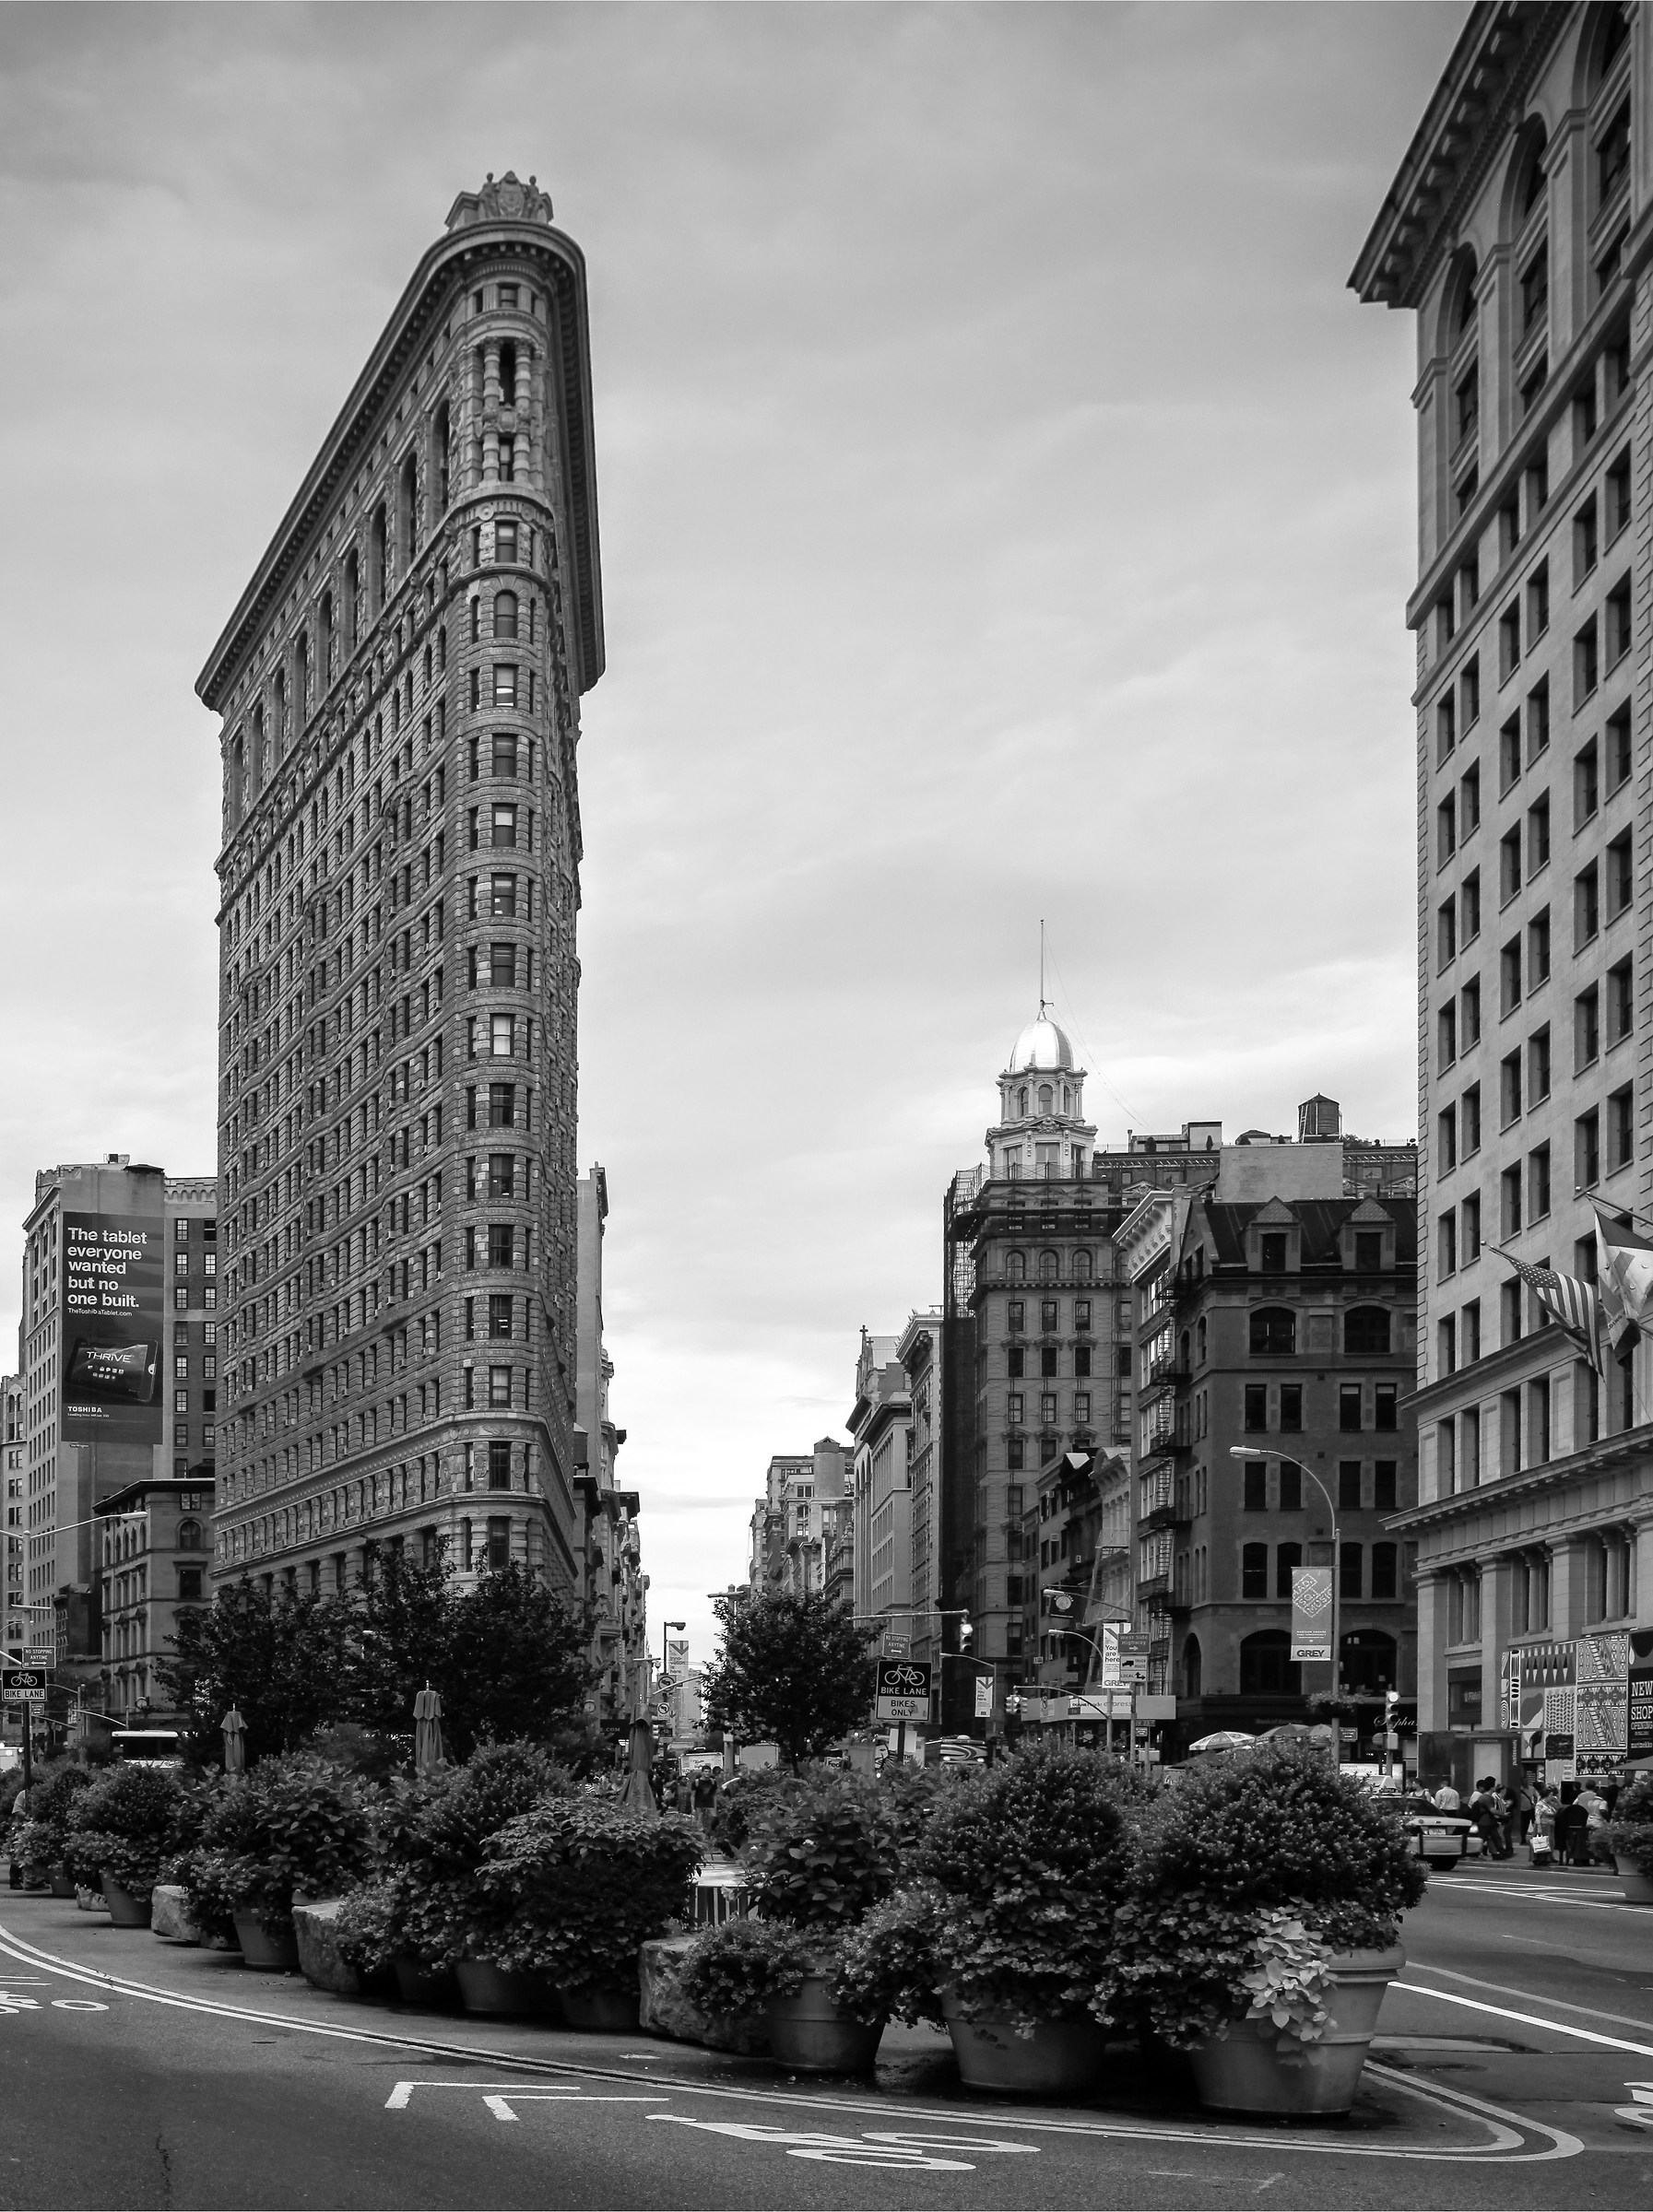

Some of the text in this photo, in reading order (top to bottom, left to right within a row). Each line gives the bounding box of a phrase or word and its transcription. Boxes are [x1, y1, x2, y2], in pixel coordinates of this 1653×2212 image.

[68, 1227, 148, 1244] The tablet
[67, 1246, 142, 1261] everyone
[68, 1261, 126, 1274] wanted
[68, 1276, 119, 1290] but no
[67, 1293, 139, 1308] one built.
[1631, 1680, 1653, 1697] NEW
[891, 1700, 915, 1708] BIKES
[1631, 1706, 1653, 1721] SHOP
